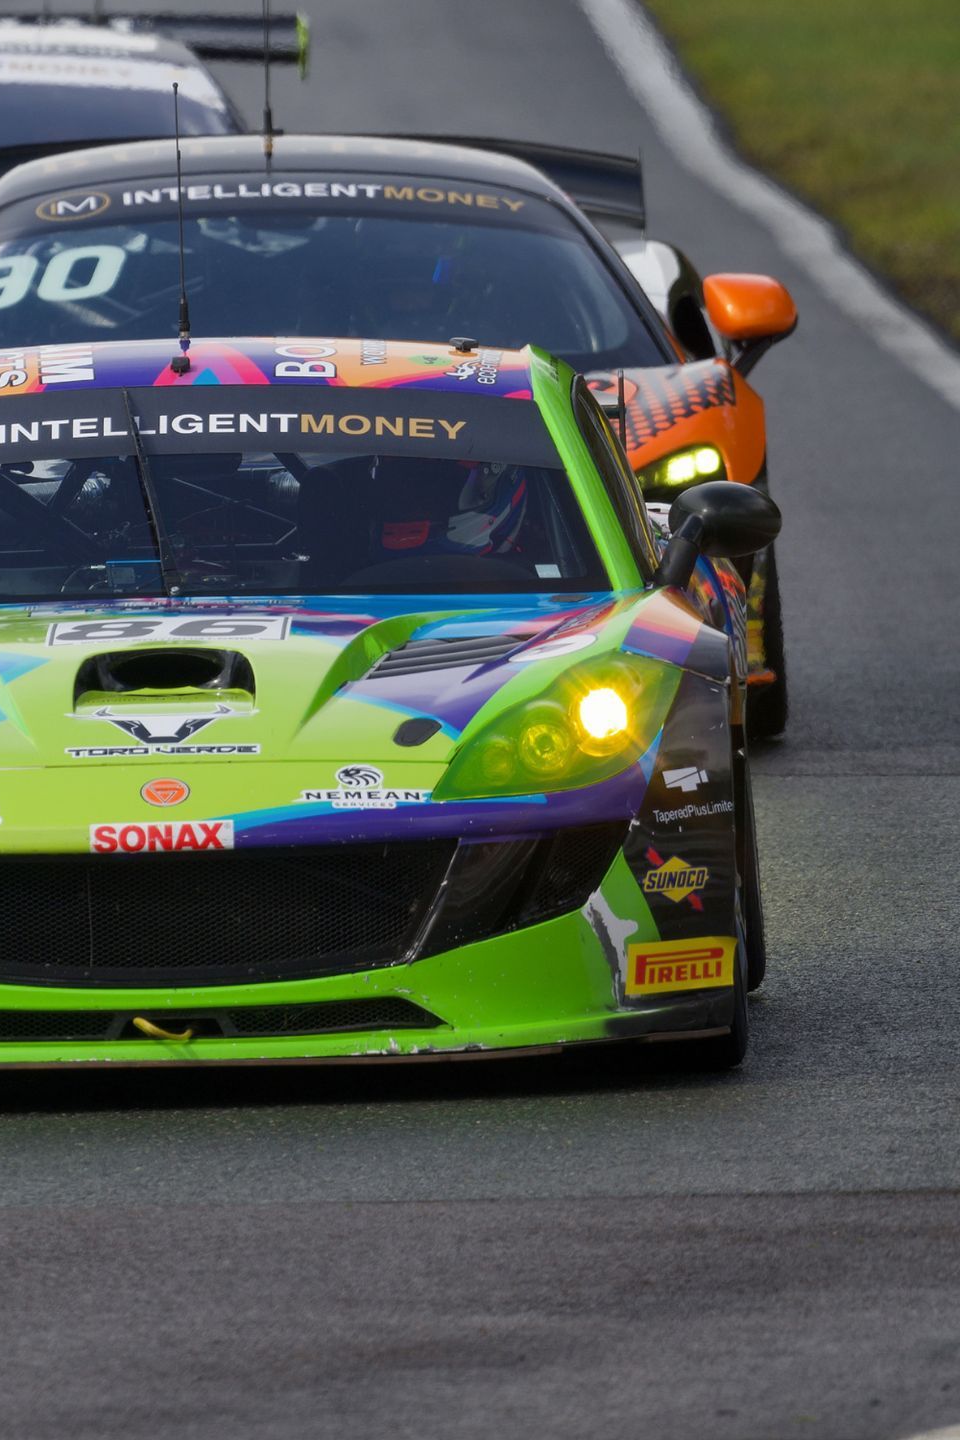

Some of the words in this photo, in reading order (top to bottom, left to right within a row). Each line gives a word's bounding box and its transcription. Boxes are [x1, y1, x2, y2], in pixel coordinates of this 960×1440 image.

[123, 182, 526, 212] INTELLIGENTMONEY
[56, 618, 279, 641] 86
[68, 747, 149, 757] TORO
[305, 791, 421, 800] NEMEAN
[92, 823, 224, 853] SONAX
[645, 869, 707, 890] SUNOCO
[635, 947, 724, 985] PIRELLI
